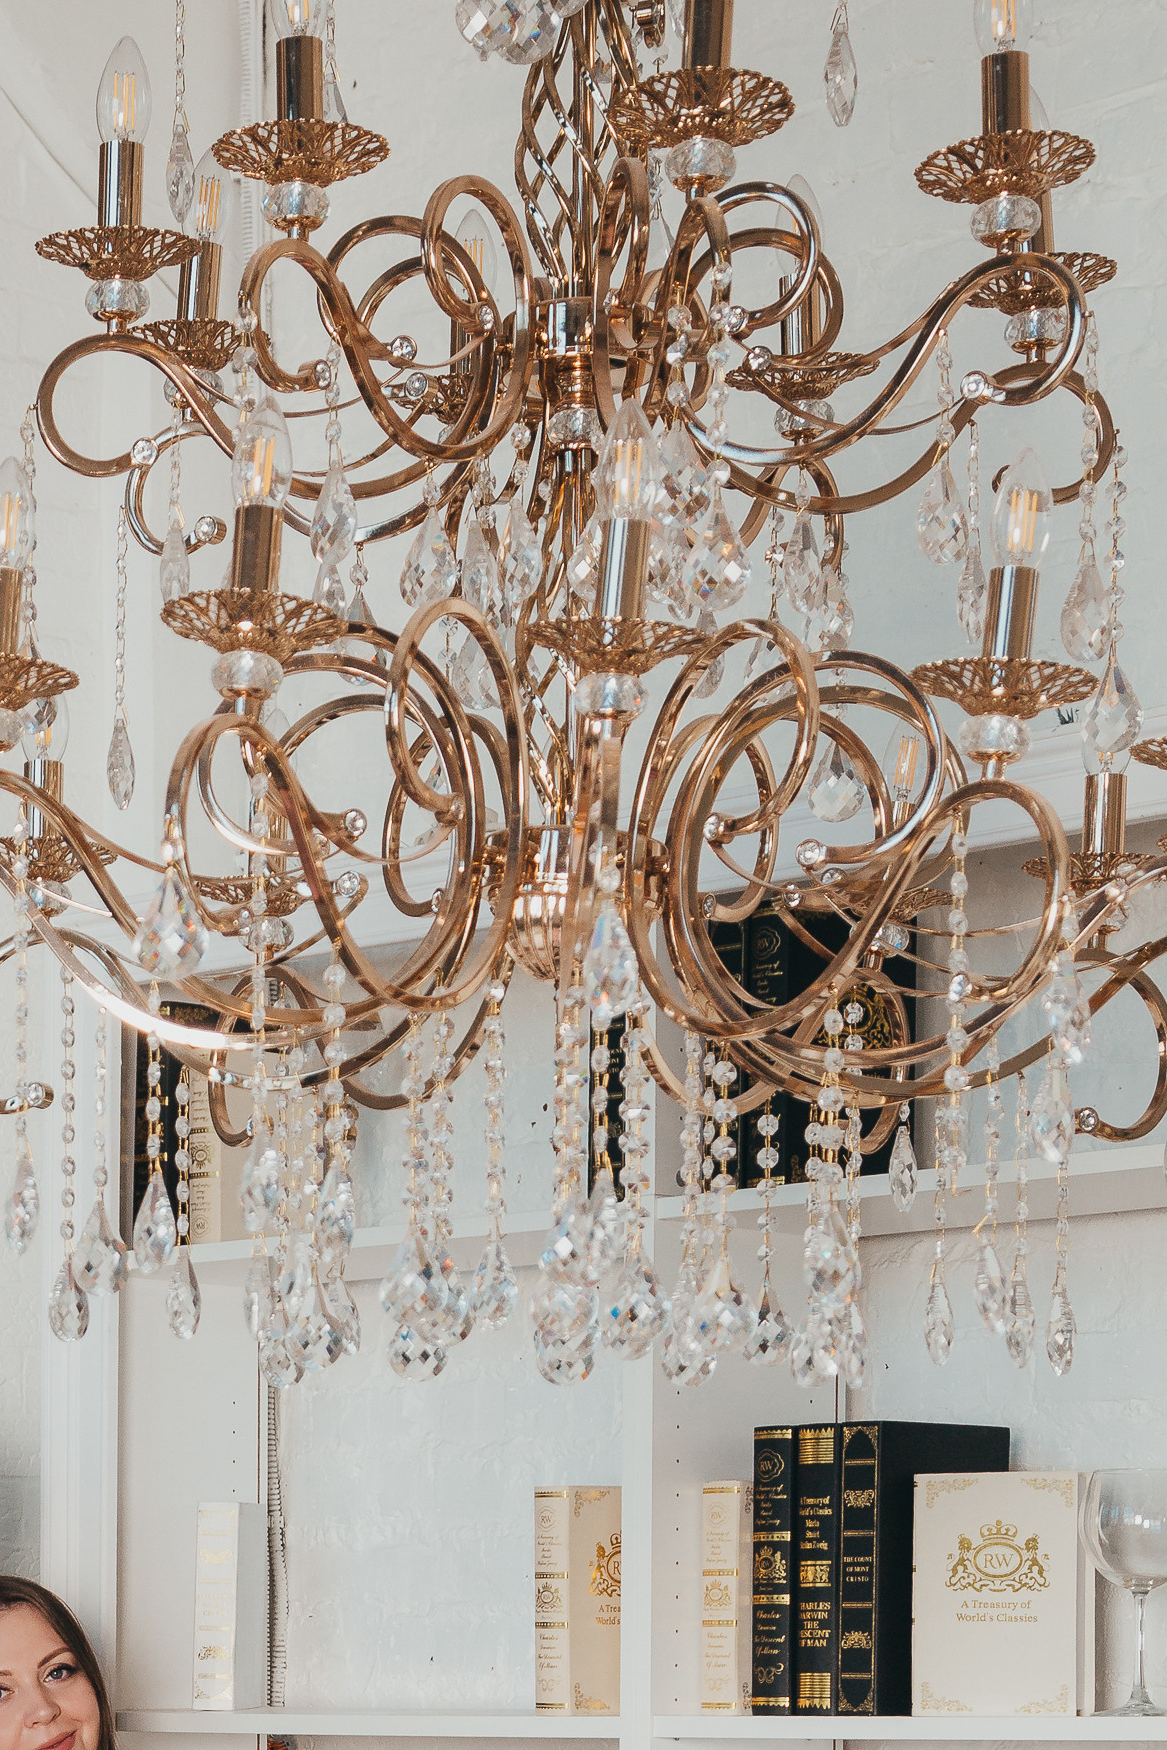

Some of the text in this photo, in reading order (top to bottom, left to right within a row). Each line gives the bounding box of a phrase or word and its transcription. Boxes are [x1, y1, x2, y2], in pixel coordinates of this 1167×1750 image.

[983, 1553, 1015, 1570] RW
[613, 1561, 621, 1575] R
[961, 1600, 1033, 1610] A Treasury of
[956, 1613, 1038, 1623] World's Classics
[803, 1621, 819, 1629] THE
[807, 1639, 827, 1647] MAN
